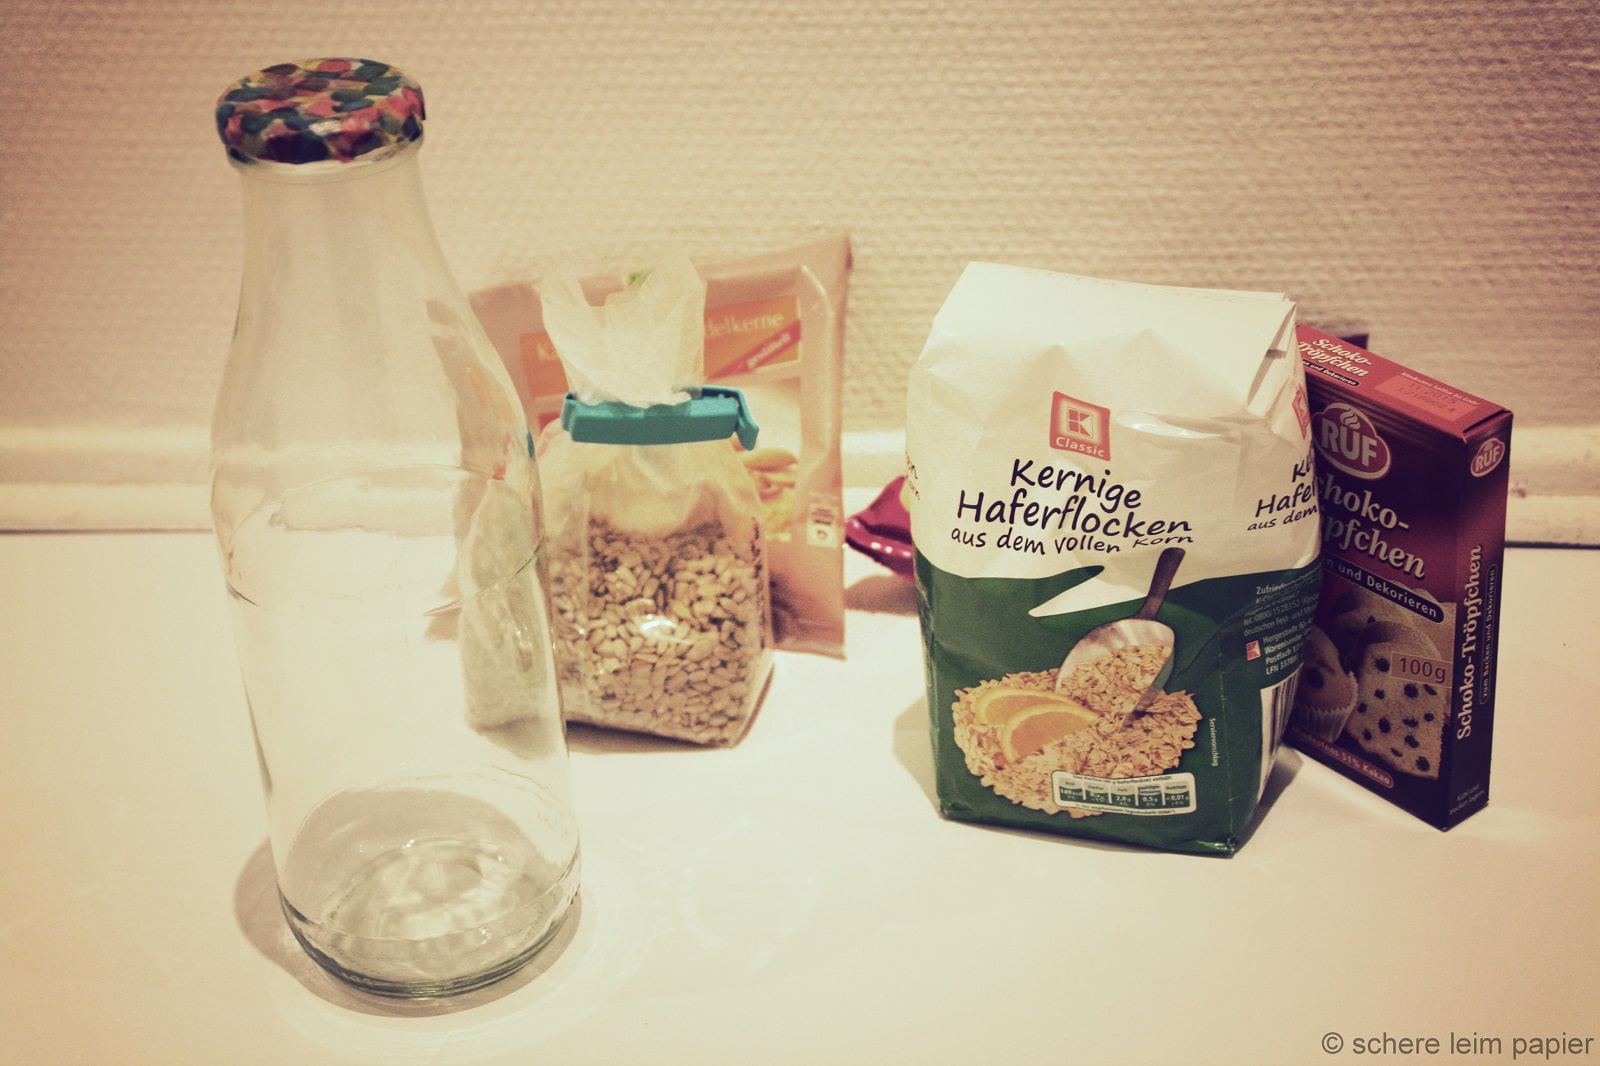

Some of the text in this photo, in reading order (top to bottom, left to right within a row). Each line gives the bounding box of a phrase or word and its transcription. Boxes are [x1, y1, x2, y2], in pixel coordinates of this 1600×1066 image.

[1312, 338, 1372, 366] Schoko-
[1055, 436, 1105, 458] Classic
[1321, 417, 1378, 468] RUF
[1475, 448, 1499, 471] RUF
[1010, 458, 1142, 514] Kernige
[957, 487, 1193, 538] Haferflocken
[1247, 505, 1318, 531] aus dem
[951, 528, 987, 549] aus
[996, 527, 1046, 556] dem
[1054, 535, 1121, 555] vollen
[1338, 563, 1438, 619] und Dekorieren
[1457, 544, 1483, 740] Schoko-Tröpfchen
[1399, 657, 1446, 684] 100g
